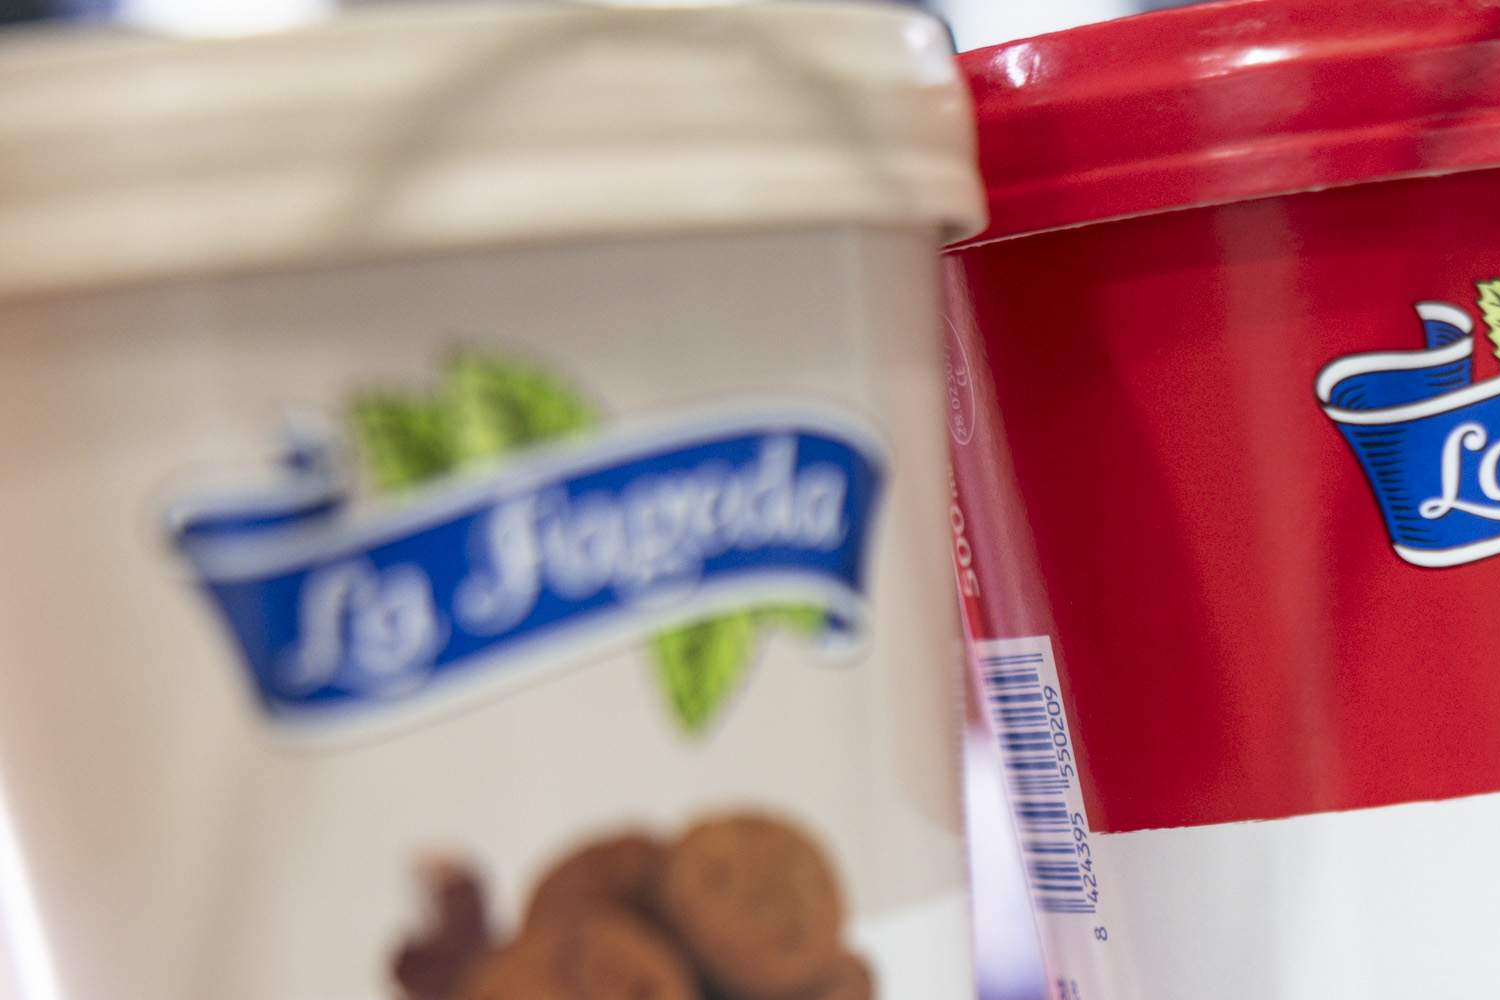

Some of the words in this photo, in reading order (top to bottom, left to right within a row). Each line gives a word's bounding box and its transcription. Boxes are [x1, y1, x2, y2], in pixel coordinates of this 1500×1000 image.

[1043, 685, 1075, 779] 550209
[1070, 811, 1099, 904] 424395
[1094, 925, 1108, 942] 8
